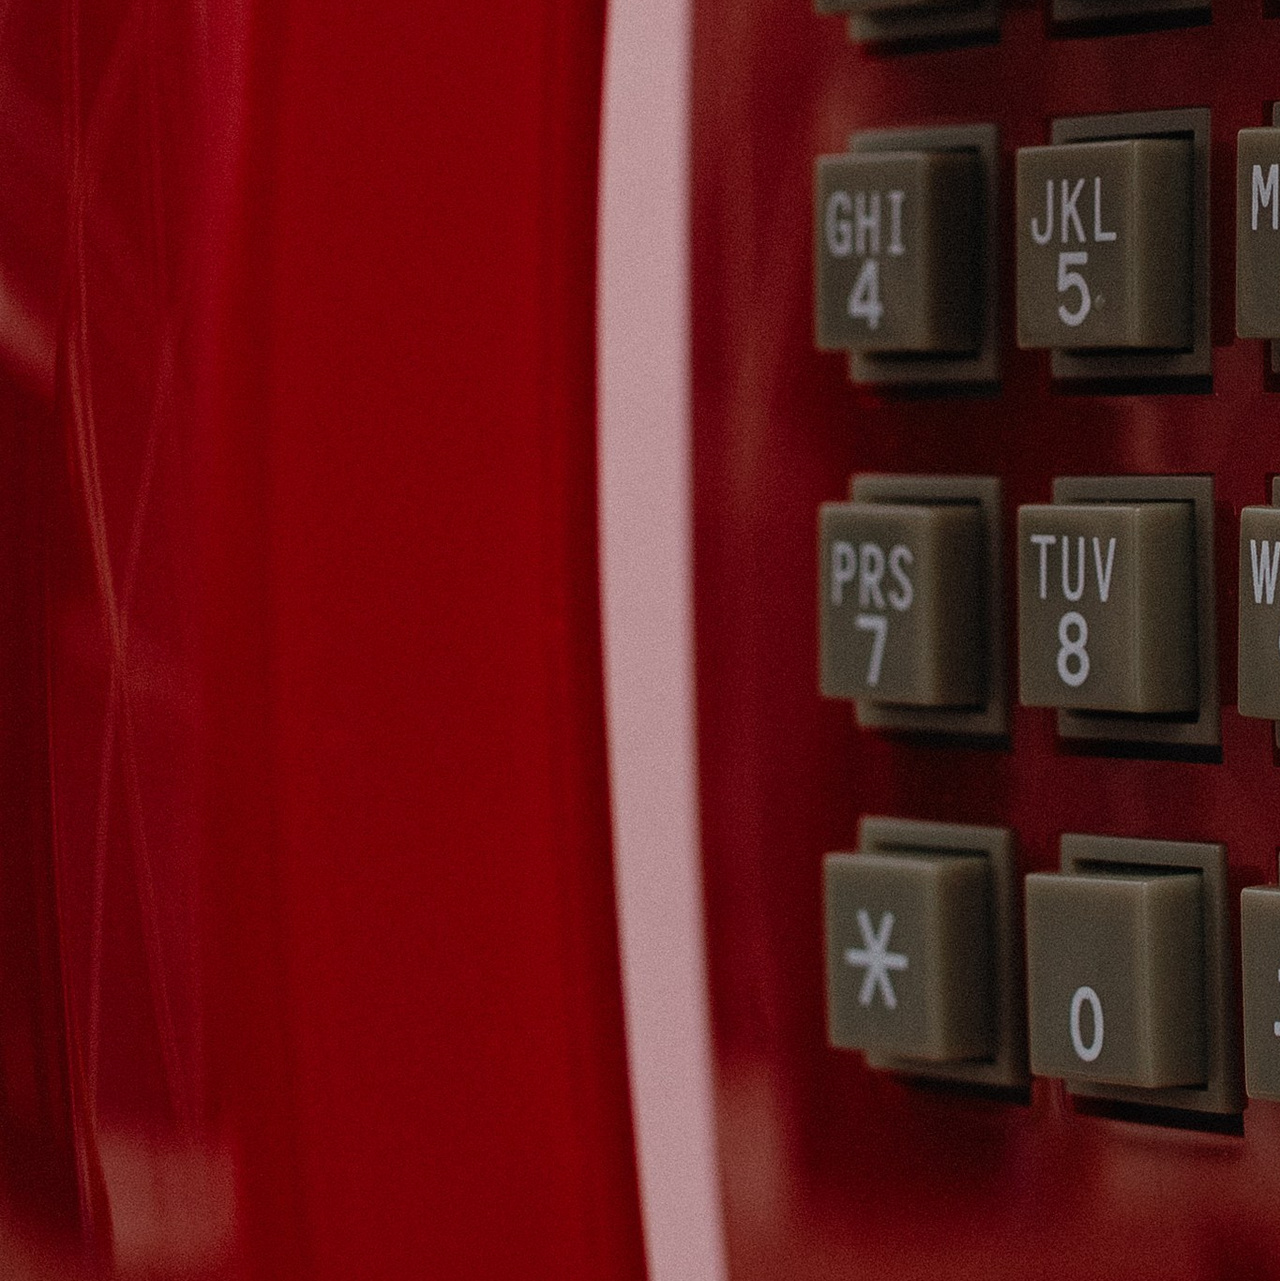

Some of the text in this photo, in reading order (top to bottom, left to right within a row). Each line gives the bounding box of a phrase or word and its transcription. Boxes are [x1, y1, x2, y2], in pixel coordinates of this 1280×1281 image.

[828, 191, 903, 255] GHI
[1030, 177, 1117, 245] JKL
[849, 260, 882, 326] 4
[1057, 251, 1091, 326] 5
[833, 542, 913, 610] PRS
[1030, 534, 1117, 603] TUV
[856, 614, 887, 684] 7
[1057, 611, 1090, 686] 8
